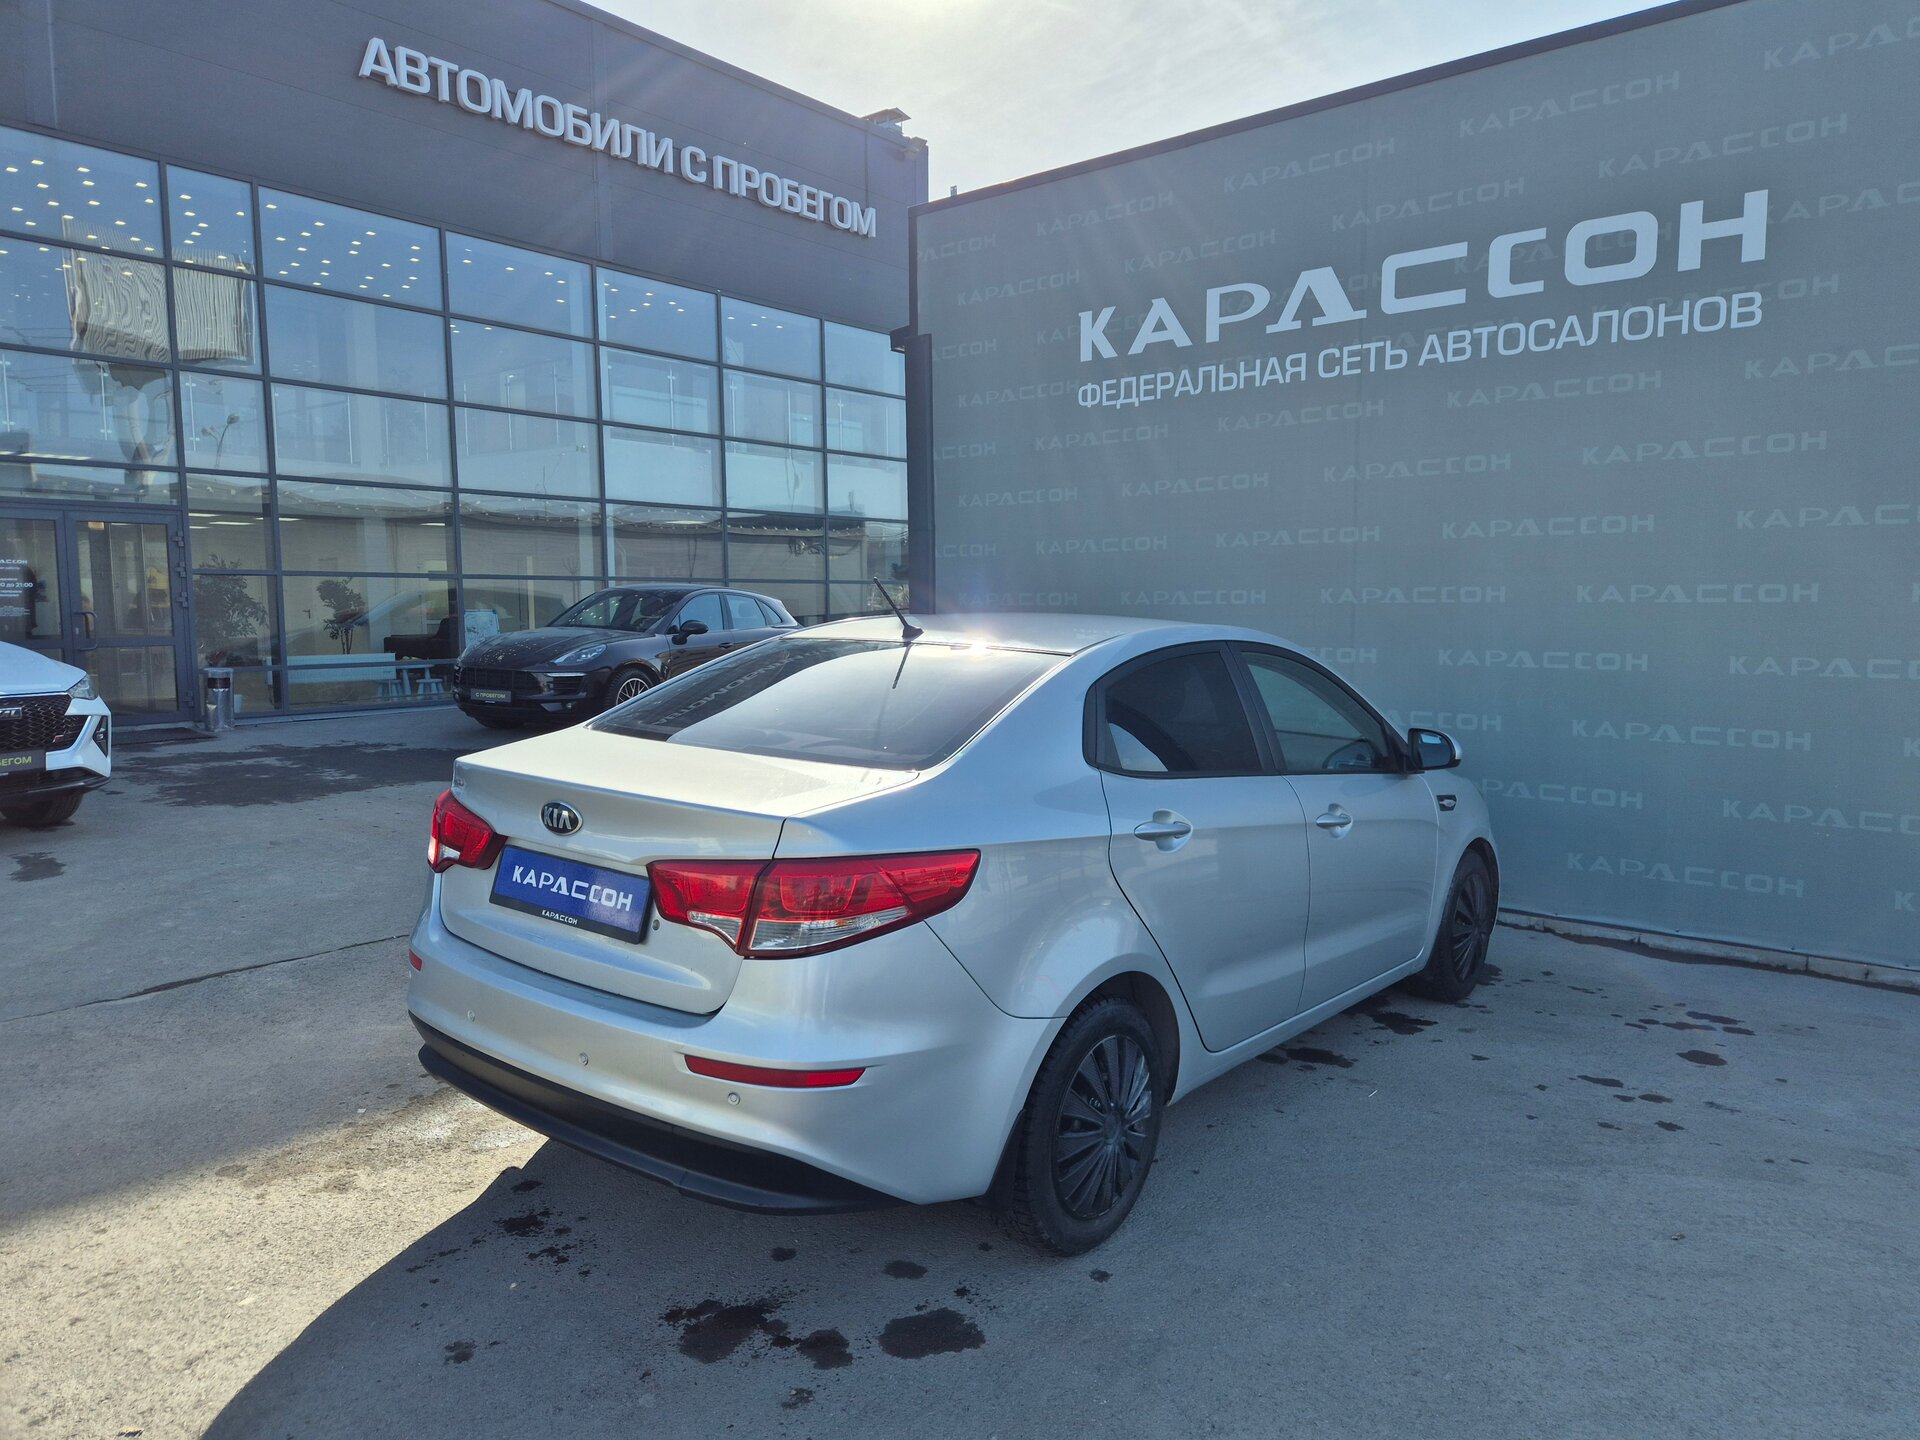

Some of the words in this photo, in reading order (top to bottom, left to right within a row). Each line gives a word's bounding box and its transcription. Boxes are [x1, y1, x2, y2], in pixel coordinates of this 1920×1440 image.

[359, 37, 673, 174] АВТОМОБИЛИ
[681, 145, 707, 183] С
[713, 155, 876, 238] ПРОБЕГОМ
[1078, 352, 1307, 409] ФЕДЕРАЛЬНАЯ
[1318, 340, 1408, 378] СЕТЬ
[1418, 291, 1763, 367] АВТОСАЛОНОВ
[543, 805, 572, 830] KIA
